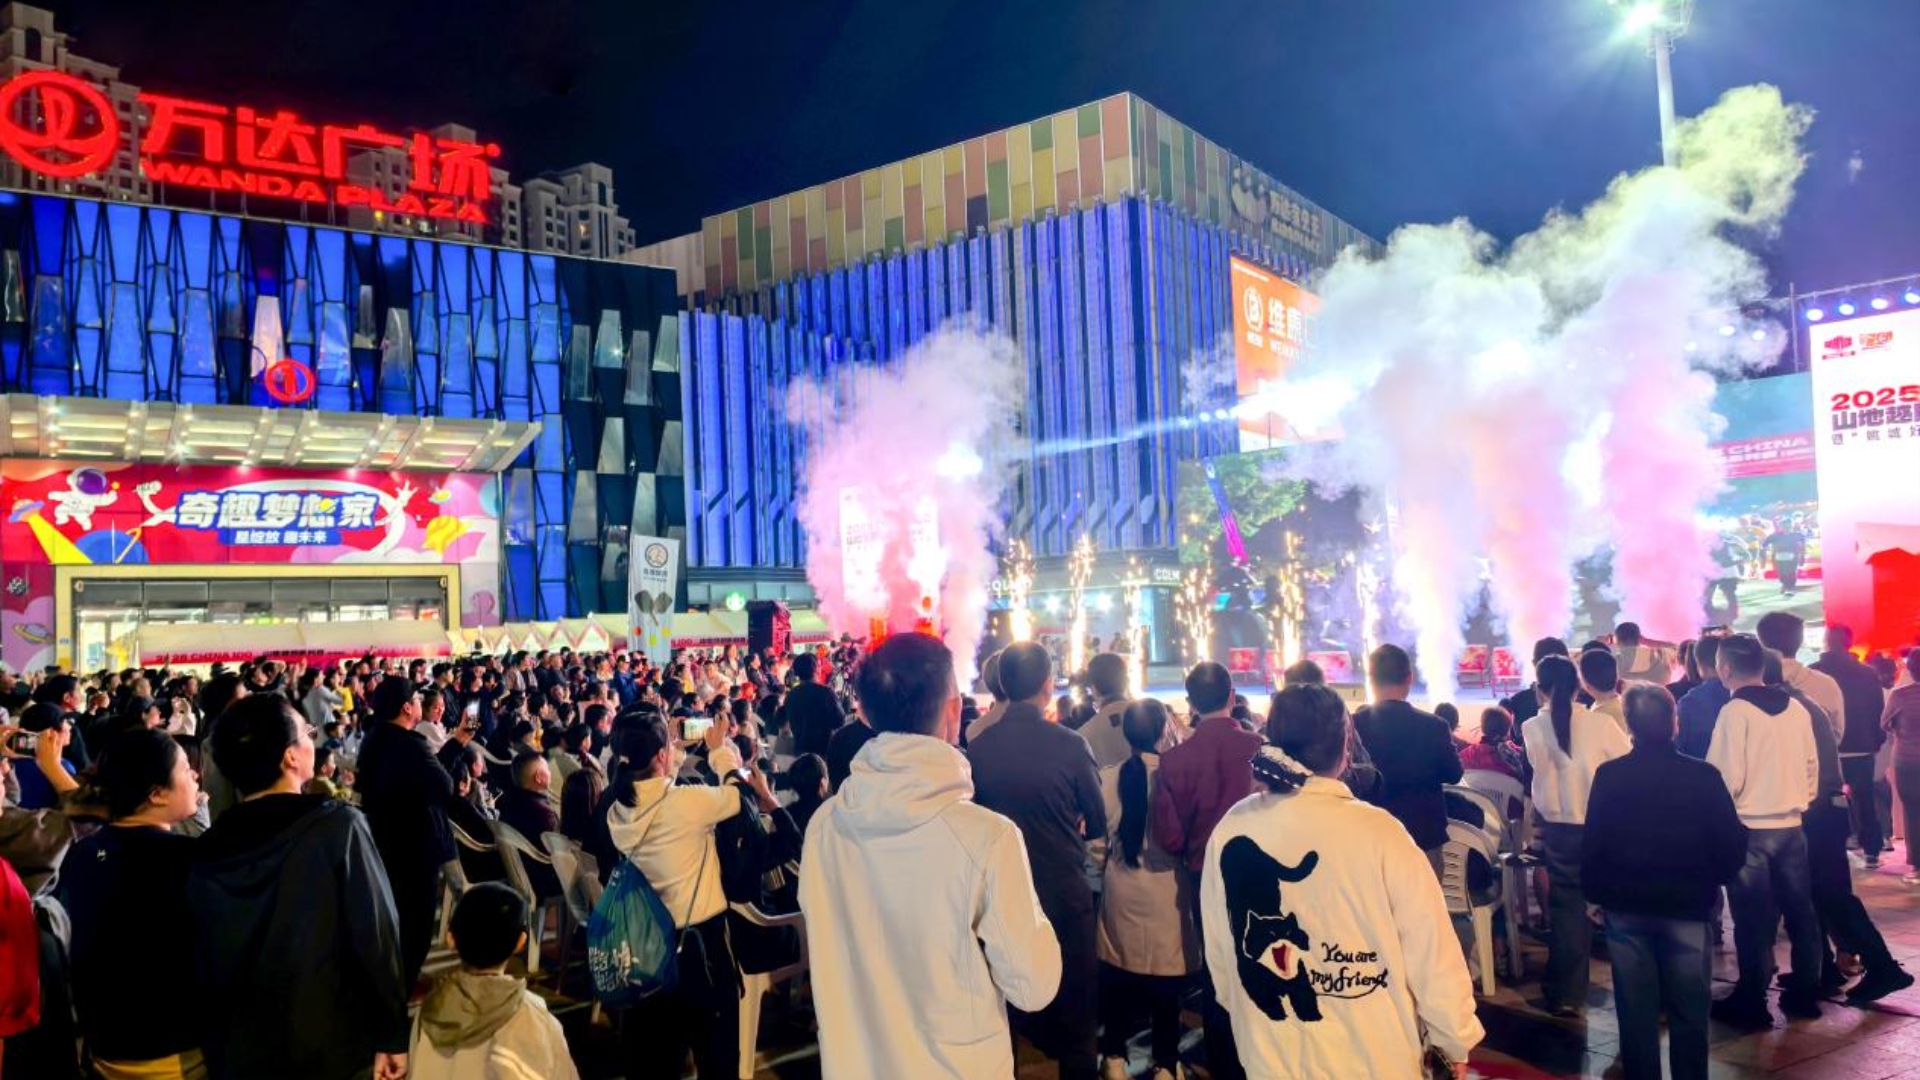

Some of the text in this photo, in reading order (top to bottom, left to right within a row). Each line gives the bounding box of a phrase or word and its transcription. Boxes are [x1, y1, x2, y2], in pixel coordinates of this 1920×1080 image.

[136, 93, 500, 199] 万达广场
[140, 159, 487, 224] WANDA PLAZA
[1831, 384, 1920, 411] 2025
[1728, 437, 1810, 455] CHINA
[177, 491, 376, 529] 奇趣梦想家
[1321, 942, 1378, 963] You are
[1310, 966, 1388, 992] my friend
